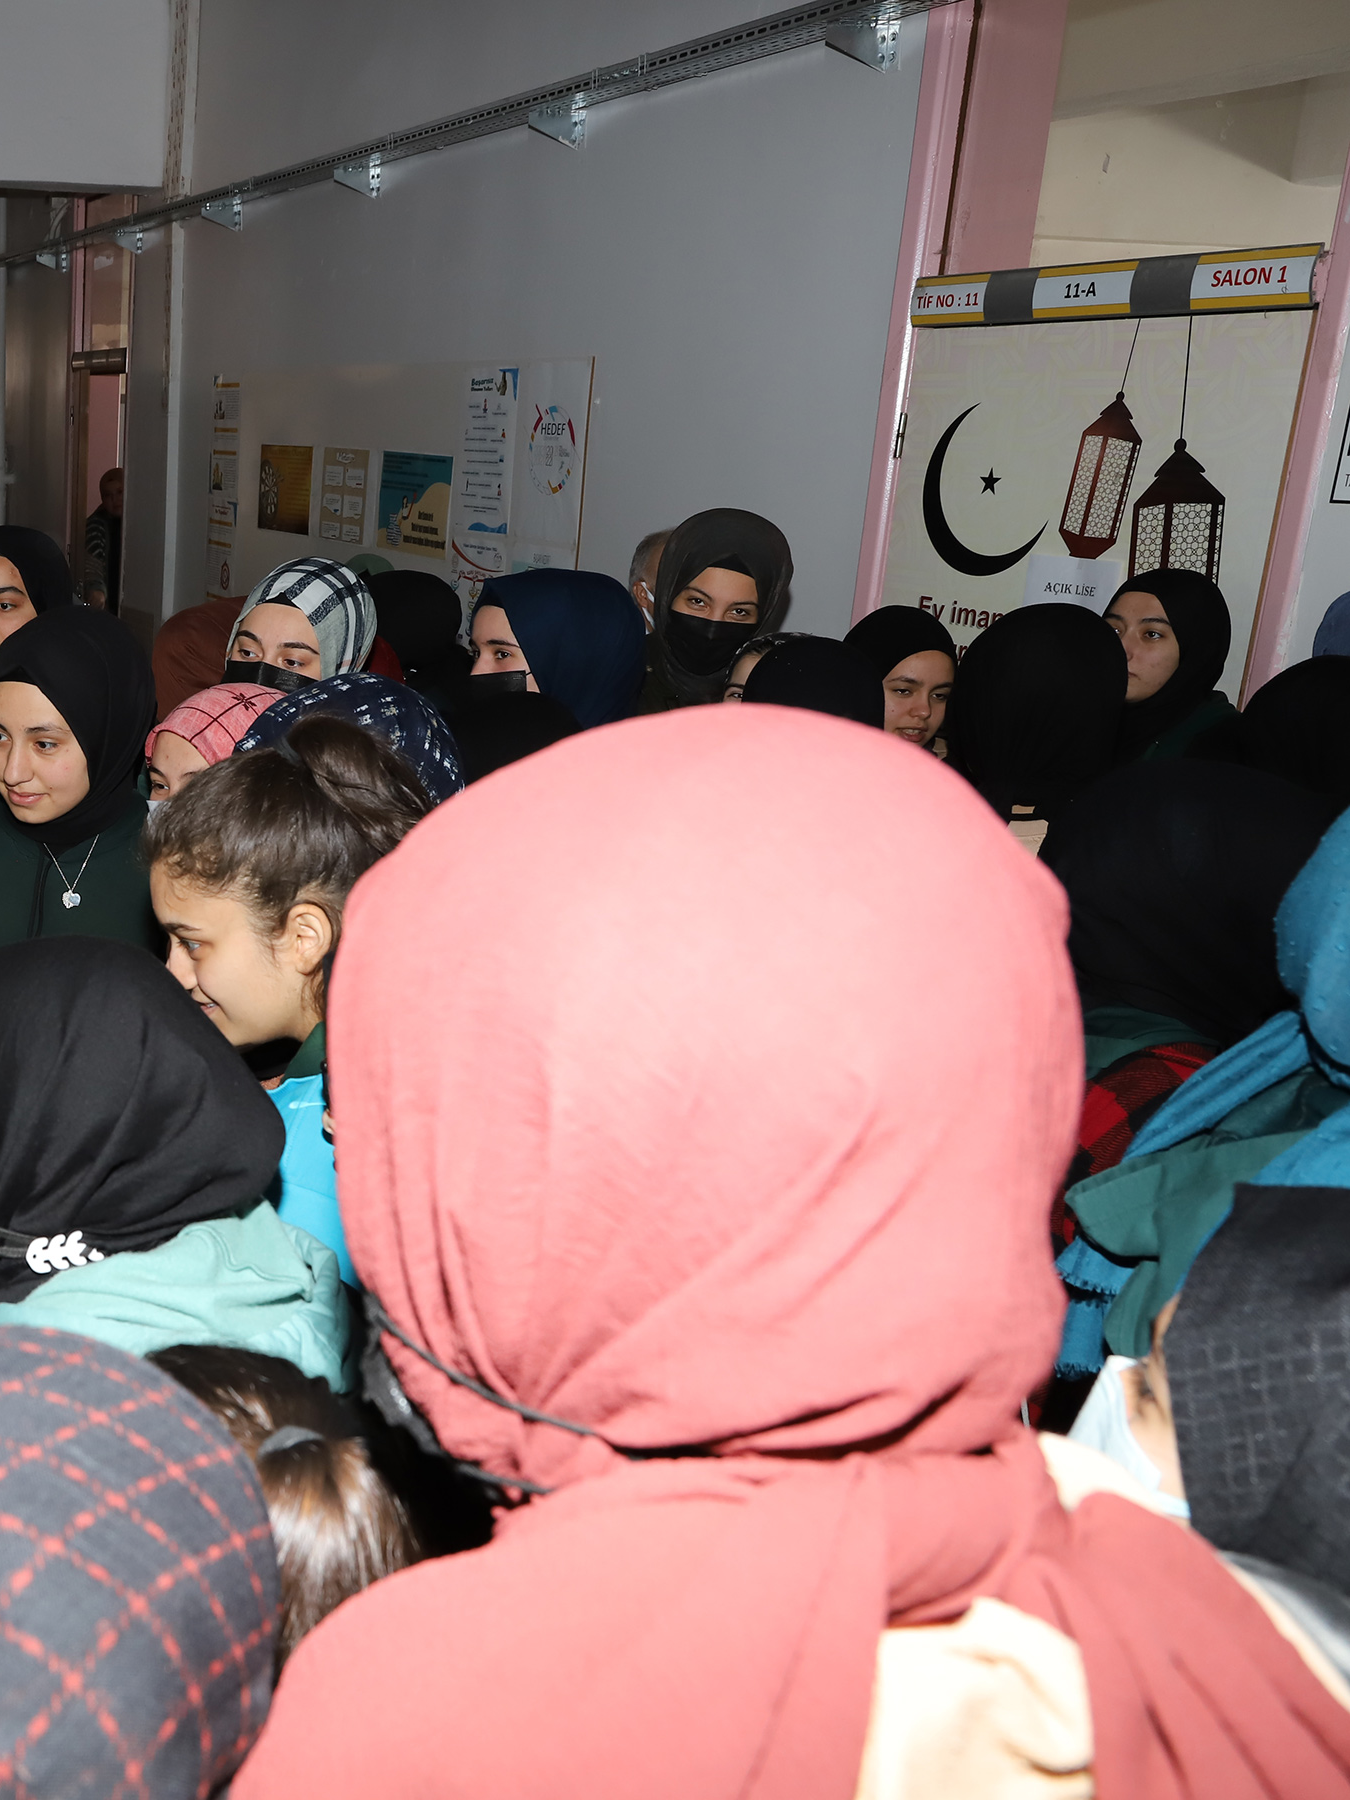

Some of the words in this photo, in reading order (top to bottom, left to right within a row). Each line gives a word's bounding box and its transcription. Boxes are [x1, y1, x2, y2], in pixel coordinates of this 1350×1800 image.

[1211, 266, 1273, 287] SALON
[1277, 265, 1288, 283] 1
[1063, 282, 1097, 299] 11-A
[916, 293, 933, 309] TİF
[936, 294, 954, 307] NO
[965, 292, 979, 306] 11
[540, 423, 566, 436] HEDEF
[1043, 582, 1072, 597] AÇIK
[1075, 583, 1097, 598] LİSE
